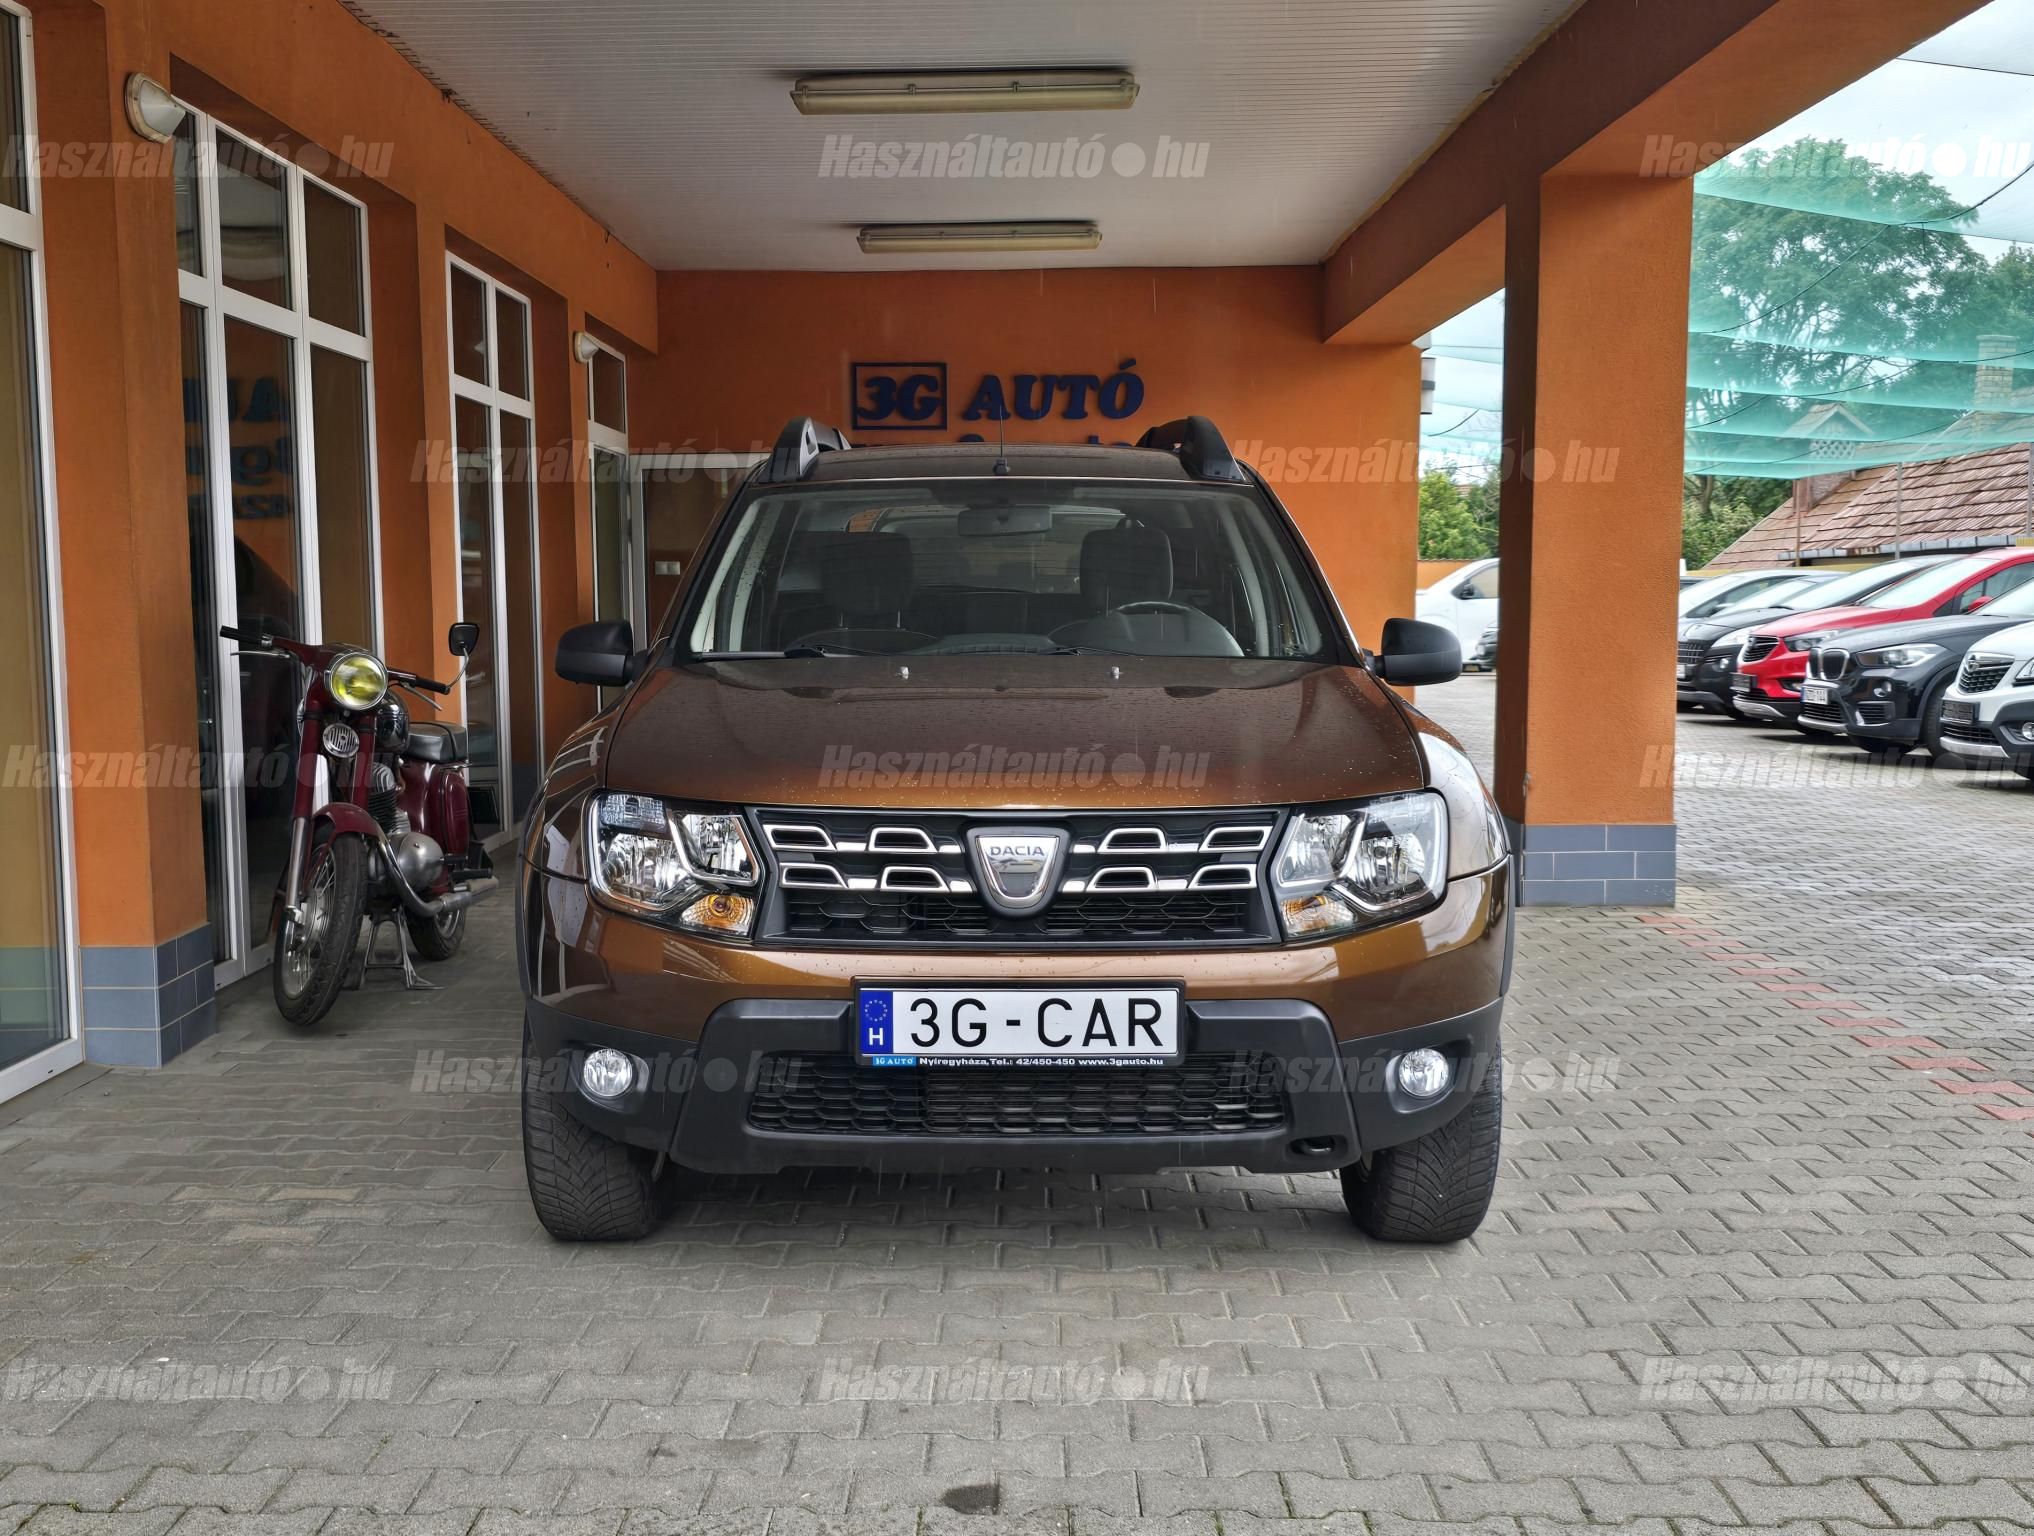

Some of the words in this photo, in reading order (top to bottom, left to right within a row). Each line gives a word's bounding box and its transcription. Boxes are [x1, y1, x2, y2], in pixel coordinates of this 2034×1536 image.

[857, 375, 941, 421] 3G
[962, 358, 1145, 421] AUTÓ
[990, 846, 1045, 856] DACIA
[868, 1027, 884, 1046] H
[1015, 1058, 1075, 1066] 42/450-450
[1078, 1058, 1164, 1067] www.3gauto.hu
